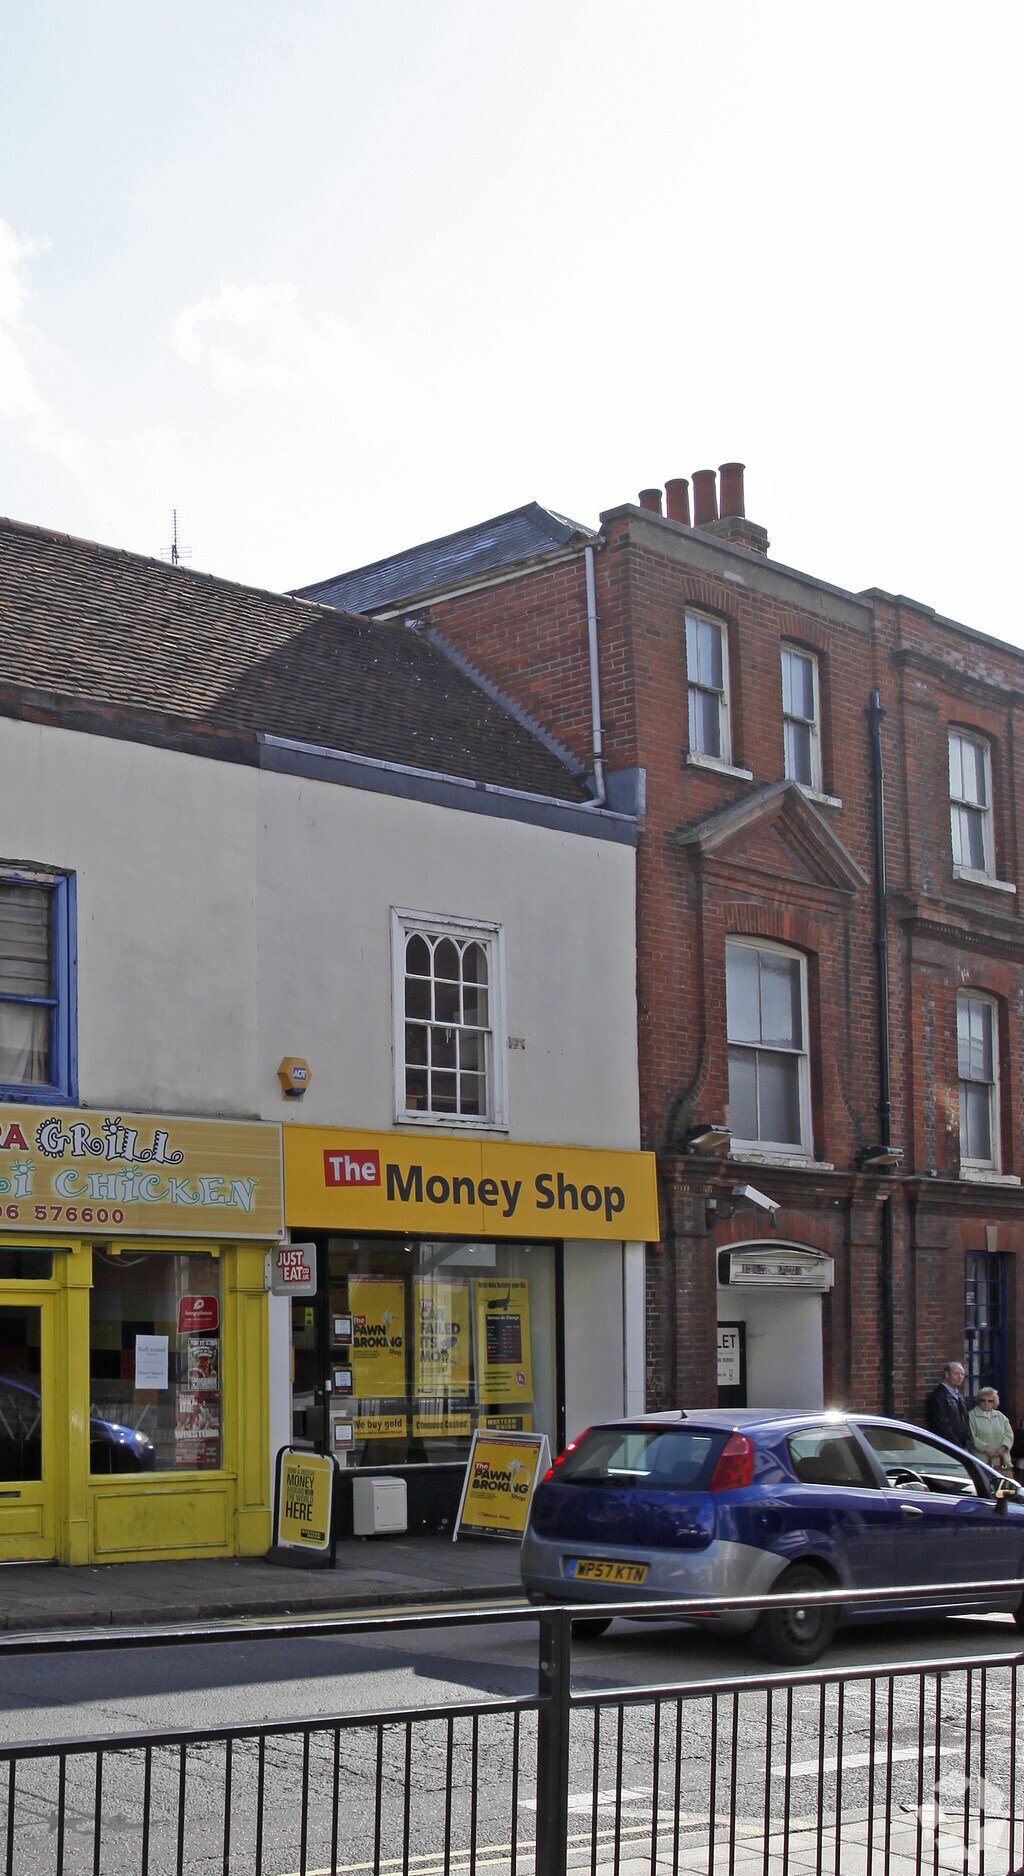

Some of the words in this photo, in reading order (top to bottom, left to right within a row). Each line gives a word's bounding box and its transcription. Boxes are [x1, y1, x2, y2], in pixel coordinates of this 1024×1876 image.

[329, 1155, 376, 1181] The
[386, 1163, 522, 1217] Money
[534, 1172, 625, 1222] Shop
[33, 1205, 126, 1224] 576600
[277, 1251, 303, 1266] JUST
[283, 1266, 303, 1281] EAT
[353, 1325, 386, 1335] PAWN
[420, 1322, 461, 1335] FAILED
[353, 1337, 403, 1348] BROKING
[420, 1336, 437, 1348] ITS
[389, 1349, 402, 1357] Shop
[367, 1420, 382, 1432] buy
[384, 1418, 402, 1431] gold
[287, 1473, 315, 1489] MONEY
[475, 1470, 512, 1482] PAWN
[472, 1480, 529, 1494] BROKING
[511, 1493, 526, 1502] Shop
[285, 1500, 313, 1522] HERE
[577, 1561, 613, 1578] WP57
[614, 1566, 646, 1582] KTN
